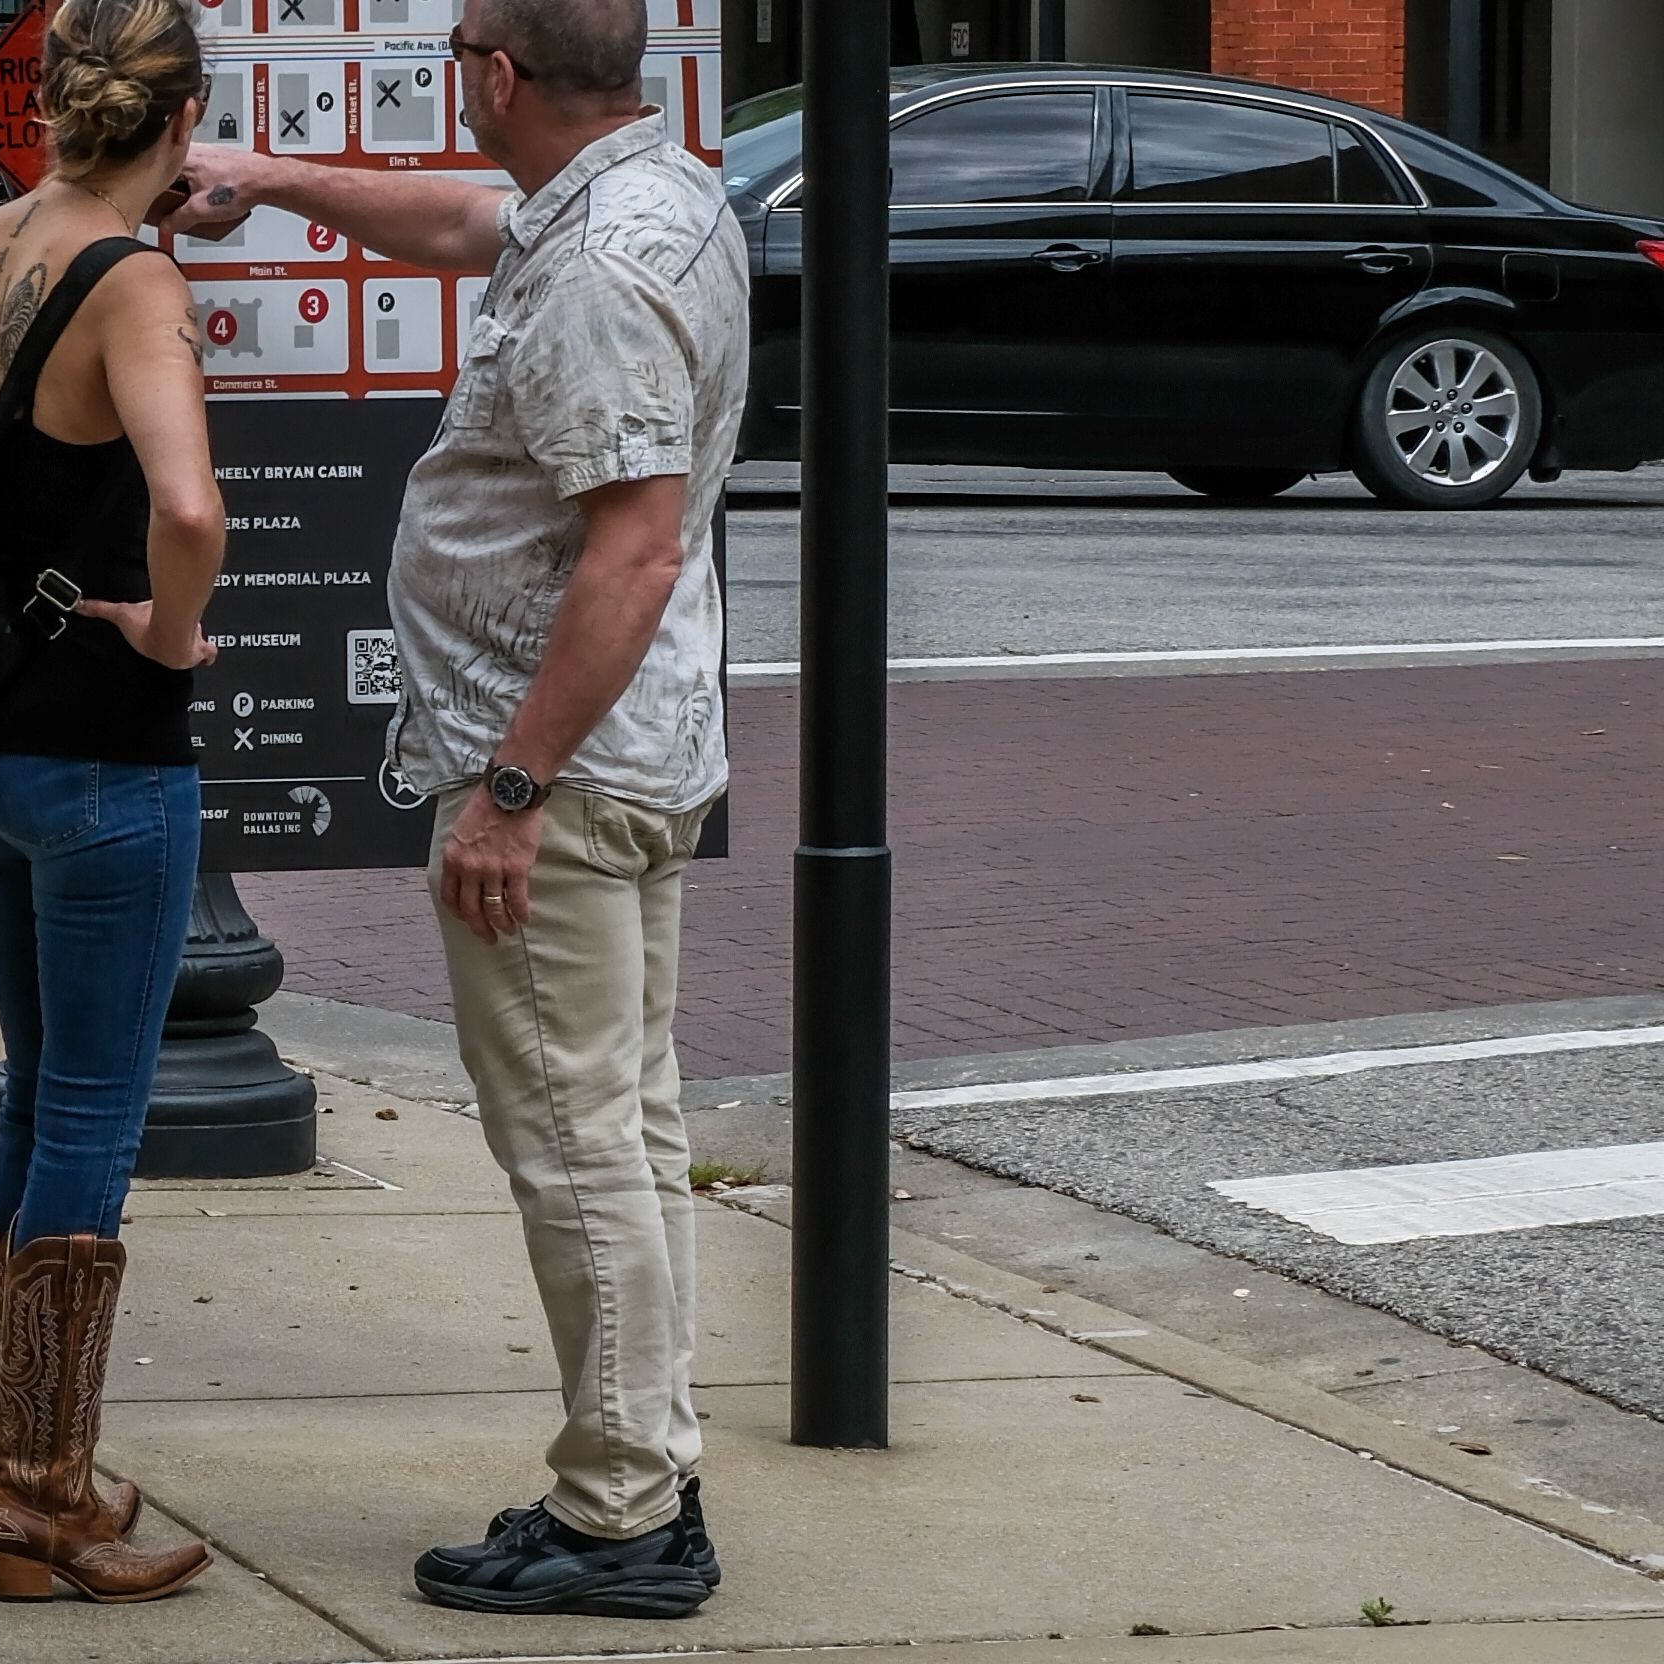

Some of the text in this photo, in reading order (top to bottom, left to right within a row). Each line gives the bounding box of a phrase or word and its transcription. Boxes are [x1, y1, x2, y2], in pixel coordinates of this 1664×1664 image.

[384, 40, 414, 50] Pacific
[416, 41, 436, 51] Ave.
[0, 56, 42, 85] RIG
[3, 89, 41, 117] LA
[256, 95, 266, 133] Record
[348, 95, 357, 134] Market
[389, 157, 421, 167] Elm St.
[315, 225, 328, 245] 2
[274, 266, 287, 276] St.
[307, 296, 320, 316] 3
[214, 318, 228, 337] 4
[213, 379, 278, 390] Commerce St.
[215, 465, 363, 480] NEELY BRYAN CABIN
[254, 516, 302, 529] PLAZA
[244, 572, 321, 586] MEMORIAL
[324, 572, 372, 585] PLAZA
[208, 634, 302, 648] RED MUSEUM
[260, 699, 315, 711] PARKING
[260, 733, 303, 744] DINING
[243, 811, 301, 822] DOWNTOWN
[243, 824, 301, 834] DALLAS INC
